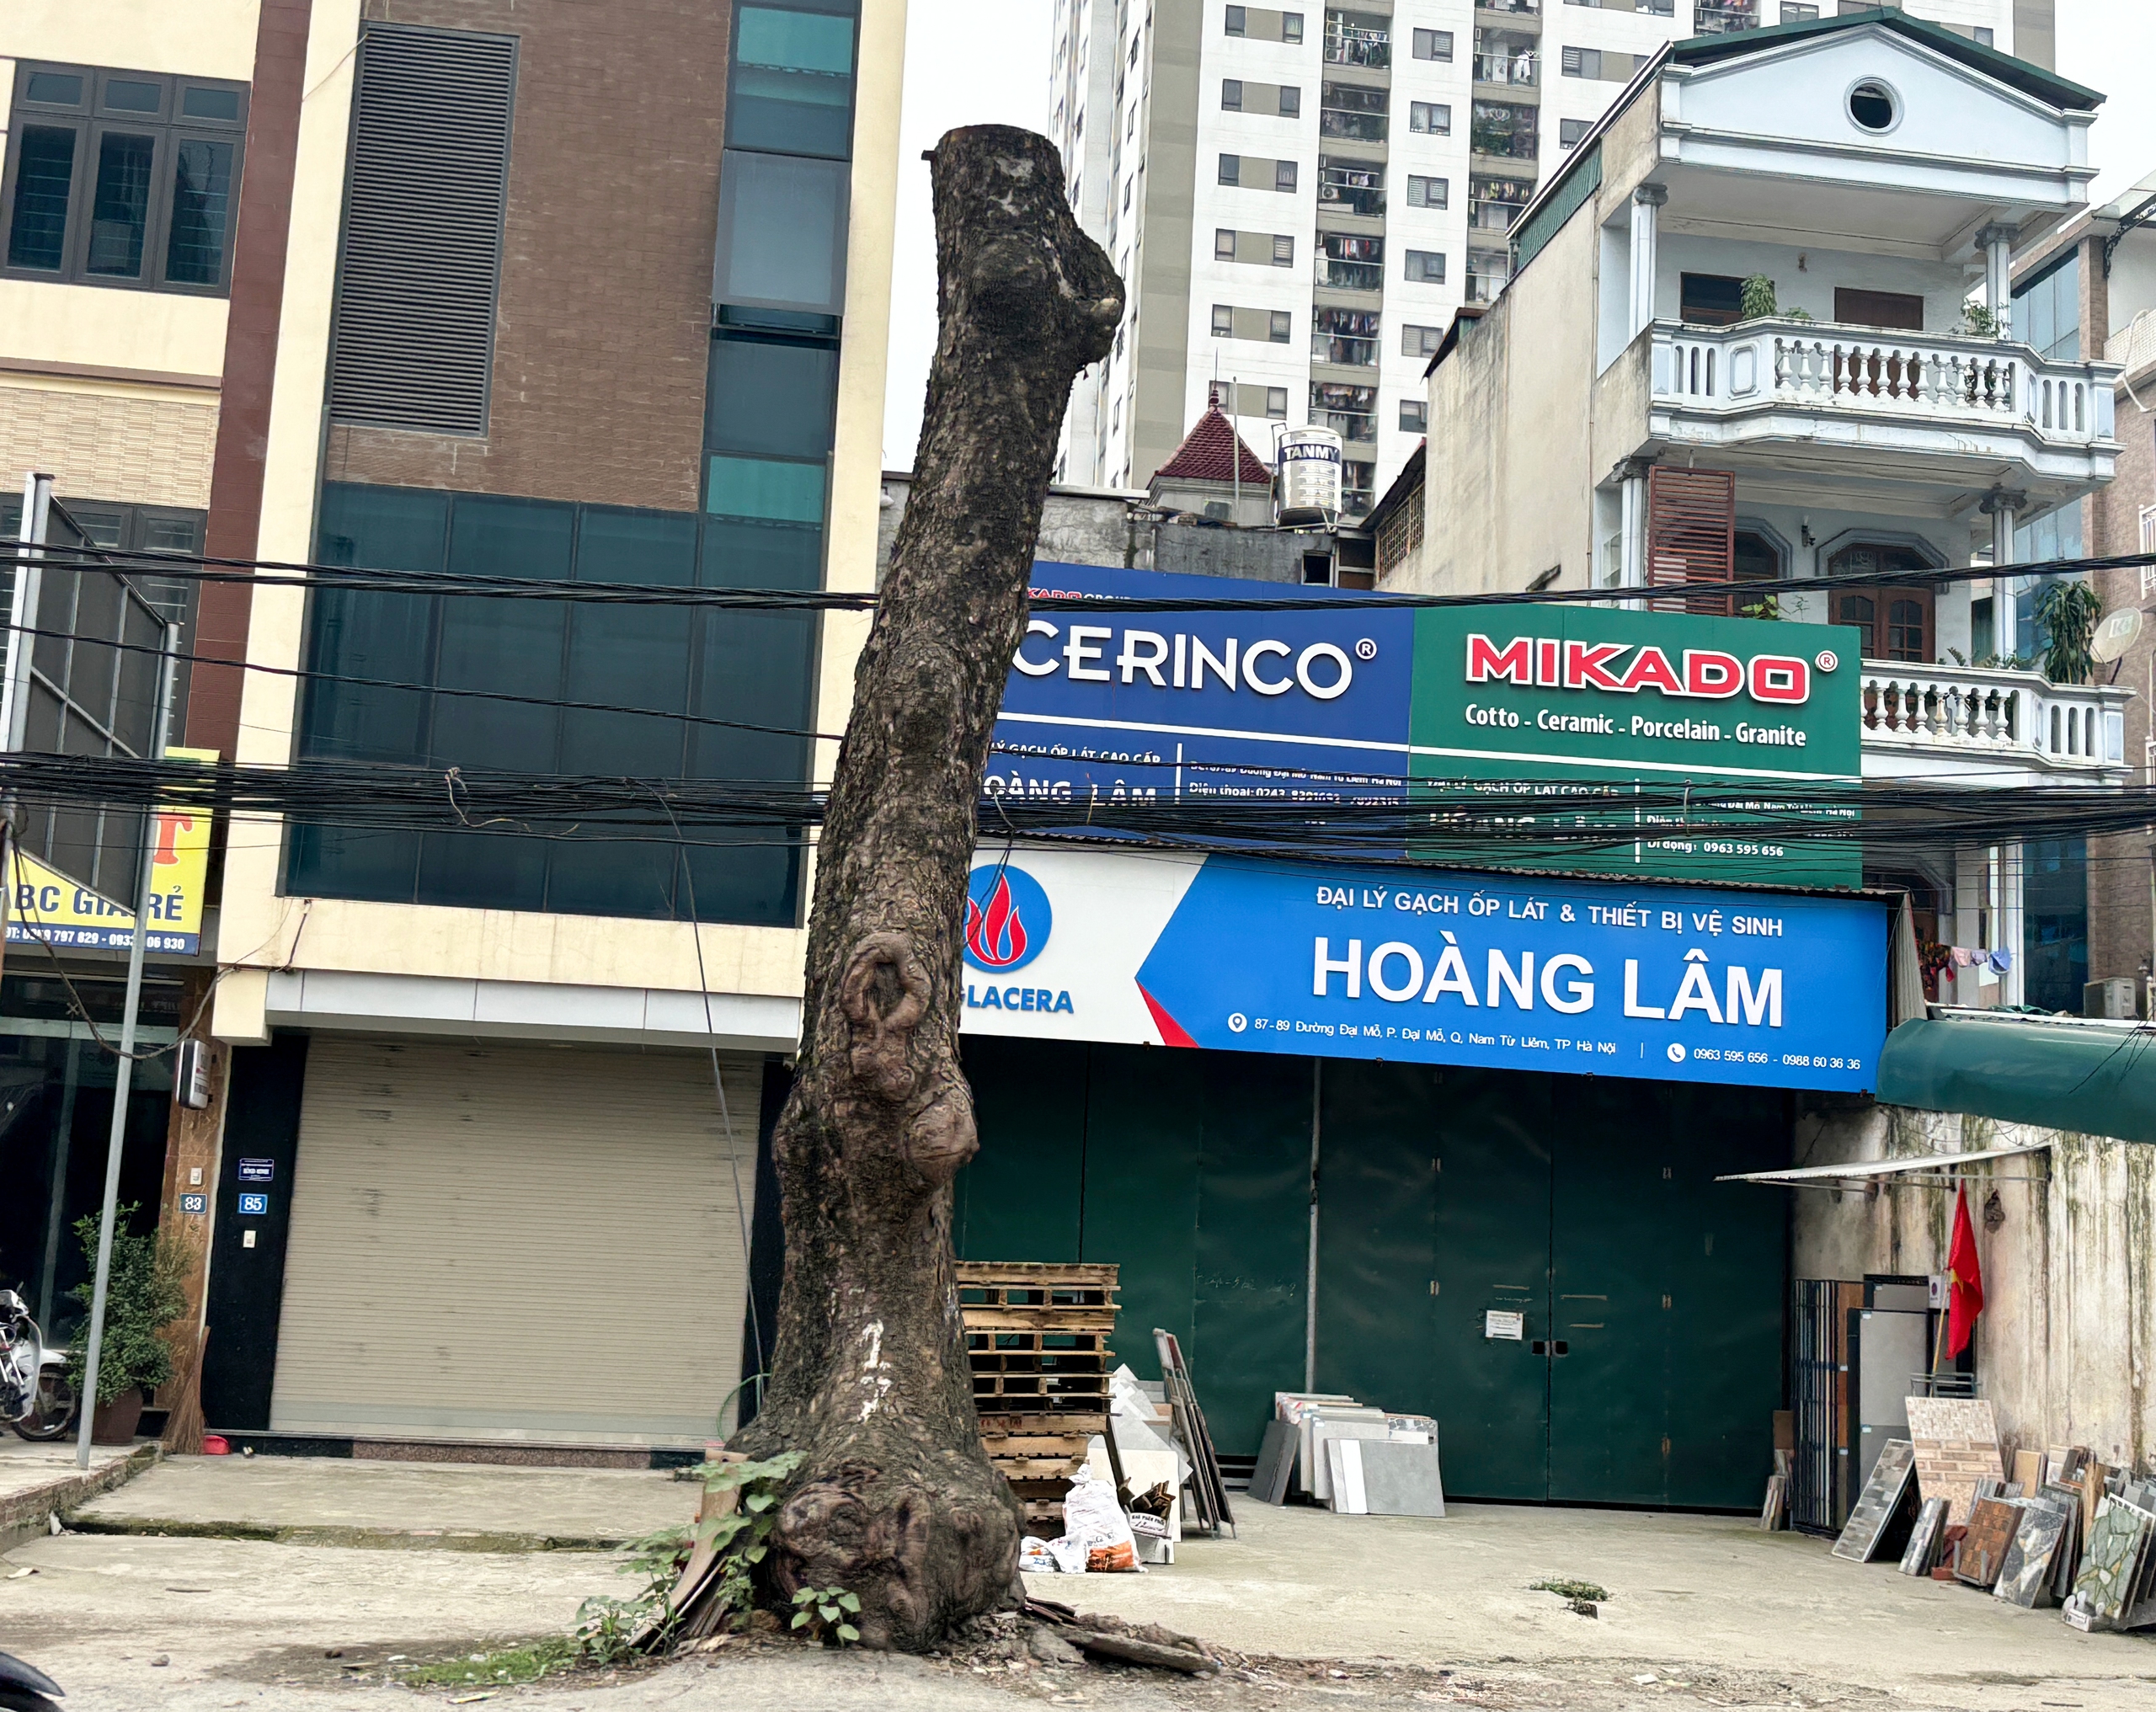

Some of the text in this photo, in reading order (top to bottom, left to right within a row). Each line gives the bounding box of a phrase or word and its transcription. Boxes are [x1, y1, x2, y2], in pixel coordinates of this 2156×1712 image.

[1465, 703, 1518, 728] Cotto
[1537, 709, 1614, 735] Ceramic
[1631, 716, 1720, 741] Porcelain
[1735, 722, 1806, 747] Granite
[984, 771, 1071, 800] OÀNG
[1704, 842, 1733, 853] 0963
[1737, 845, 1758, 854] 595
[1762, 845, 1784, 856] 656
[1316, 886, 1782, 936] ĐẠI LÝ GẠCH ỐP LÁT & THIẾT BỊ VỆ SINH
[54, 931, 75, 942] 797
[77, 932, 98, 944] 829
[163, 938, 185, 950] 930
[1313, 930, 1782, 1027] HOÀNG LÂM
[961, 984, 1074, 1014] LACERA
[1296, 1020, 1334, 1037] Đường
[1339, 1023, 1358, 1037] Đại
[1402, 1027, 1420, 1042] Đại
[1469, 1033, 1495, 1046] Nam
[1500, 1034, 1516, 1047] Từ
[1554, 1039, 1571, 1050] TP
[1577, 1040, 1593, 1053] Hà
[1598, 1042, 1616, 1055] Nội
[1694, 1048, 1721, 1061] 0963
[1724, 1050, 1745, 1063] 595
[1748, 1052, 1769, 1064] 656
[1783, 1054, 1809, 1067] 0988
[1812, 1056, 1827, 1068] 60
[1830, 1058, 1844, 1069] 36
[1847, 1059, 1861, 1070] 36
[184, 1197, 202, 1210] 83
[244, 1197, 262, 1211] 85
